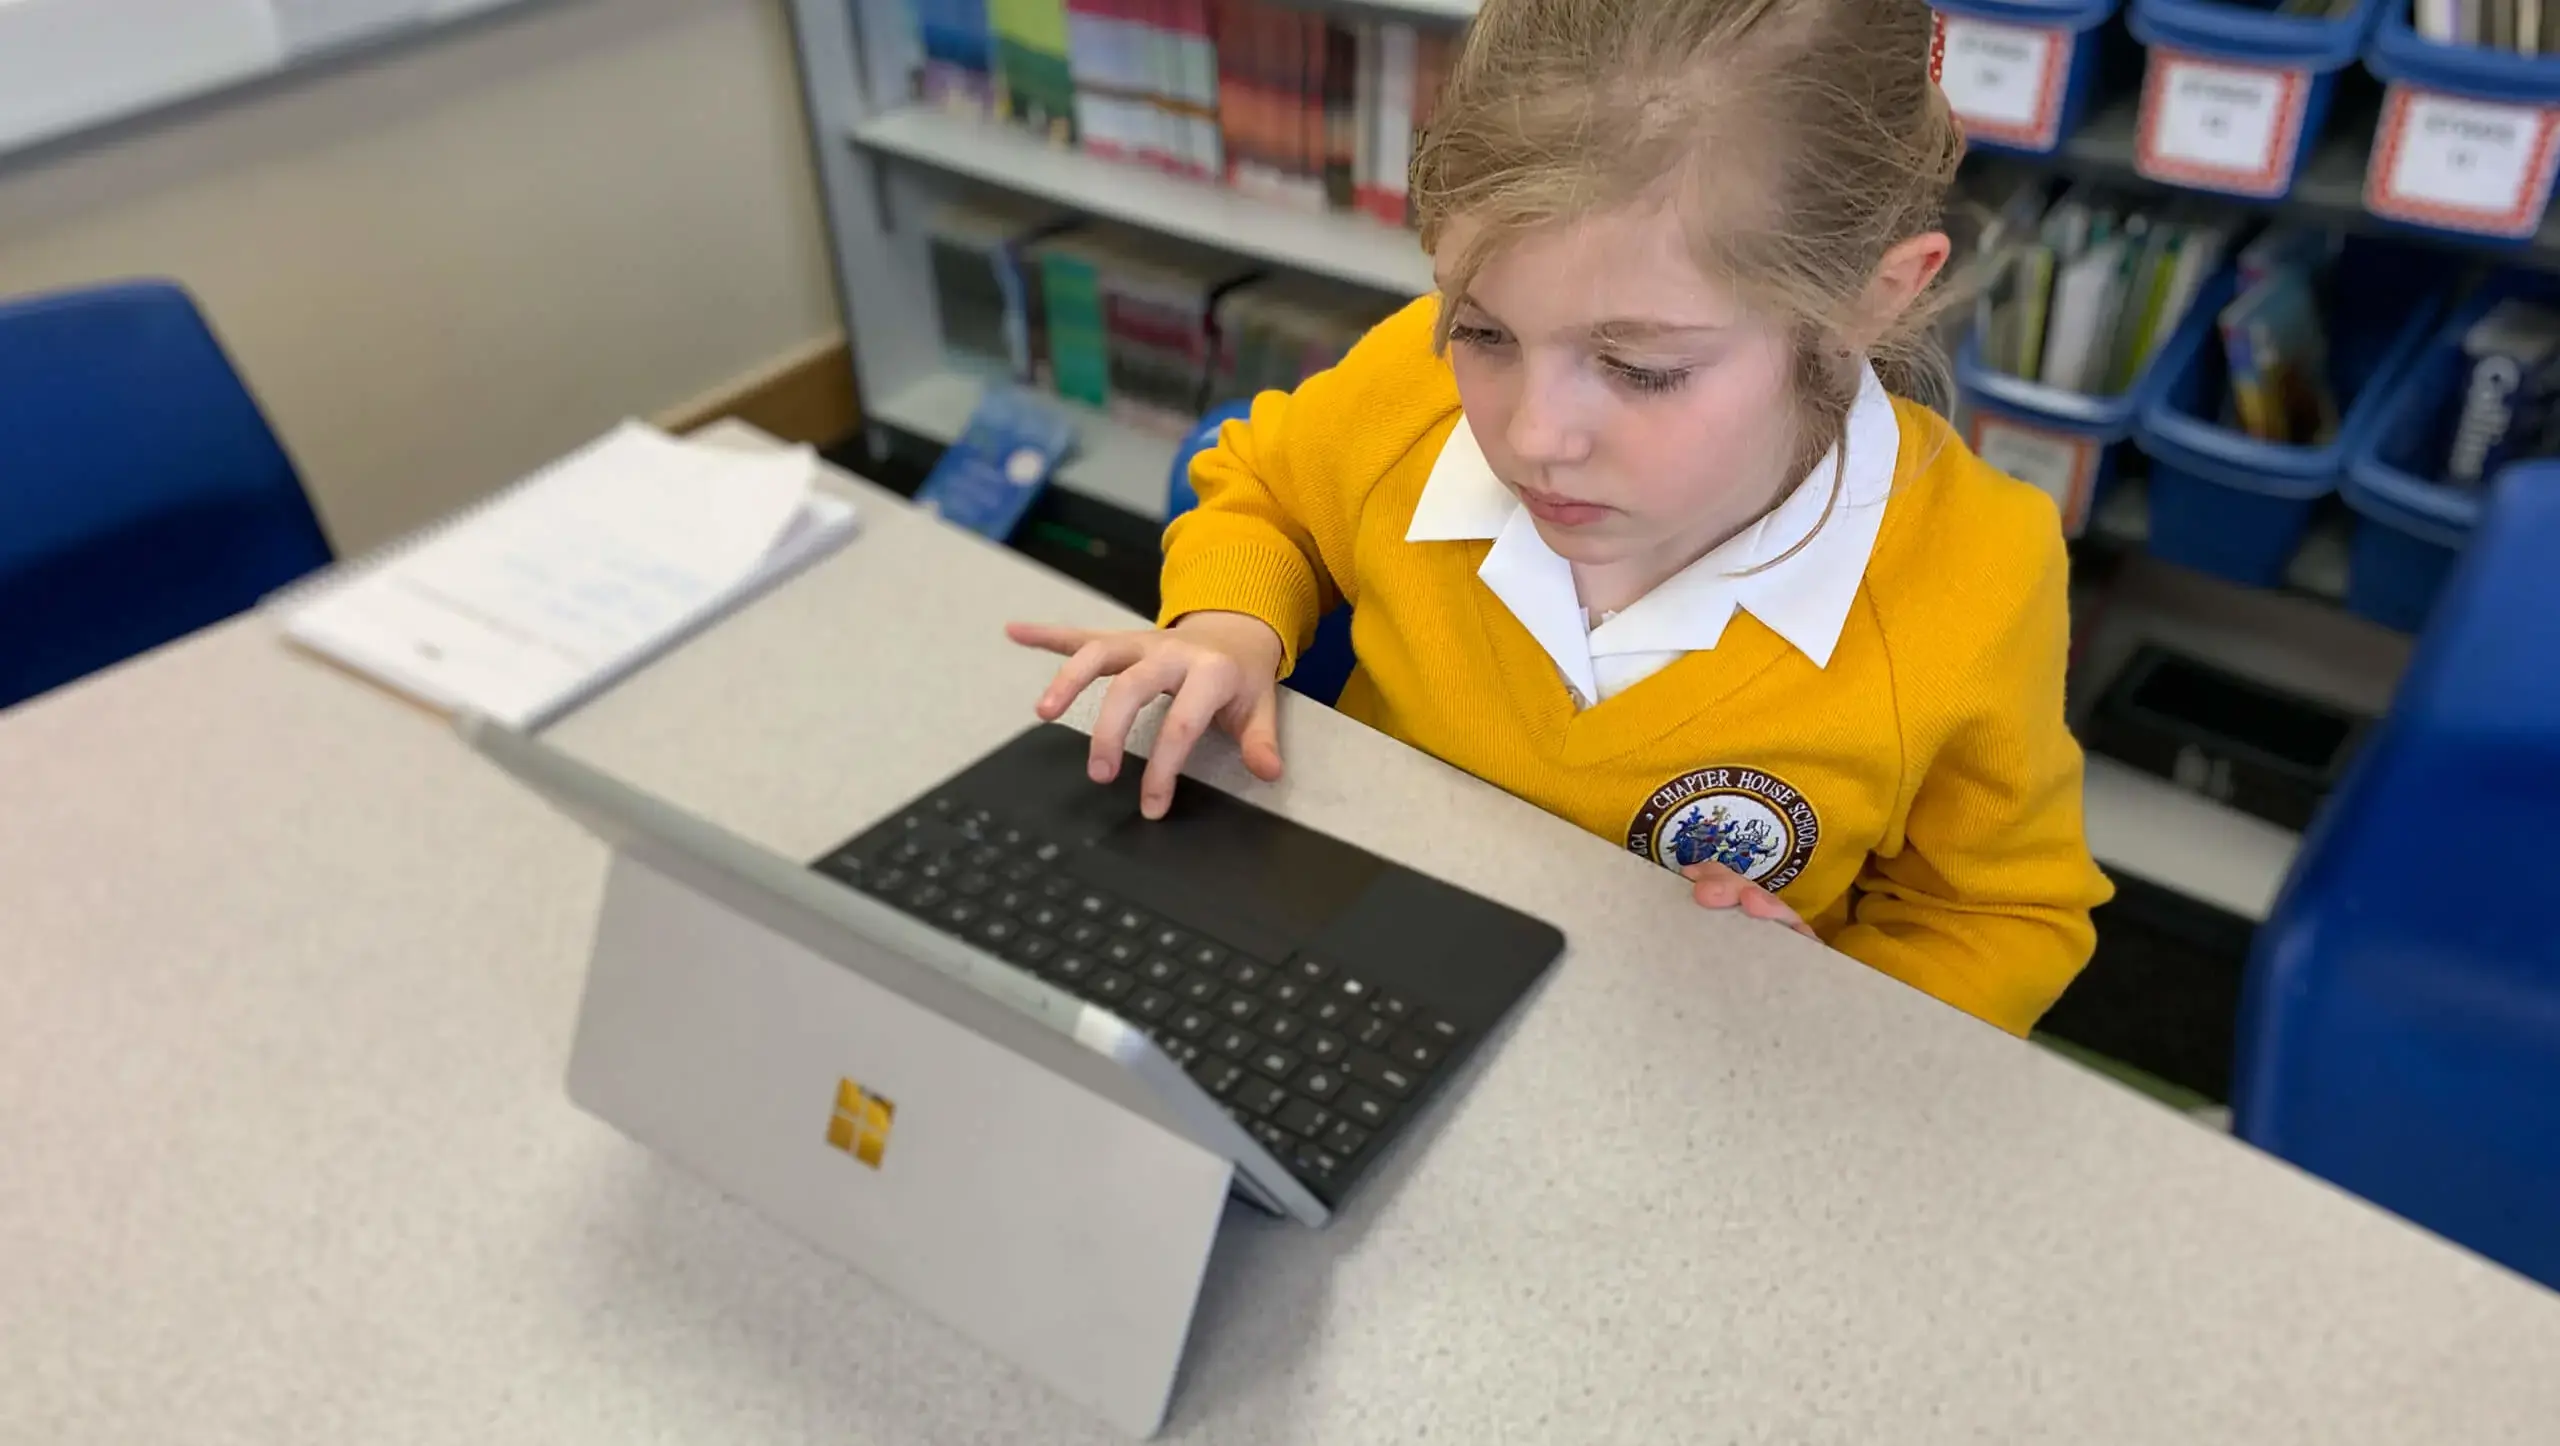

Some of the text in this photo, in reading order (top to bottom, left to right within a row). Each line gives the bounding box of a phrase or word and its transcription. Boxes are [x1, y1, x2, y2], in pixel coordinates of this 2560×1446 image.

[1653, 769, 1817, 853] CHAPTER HOUSE SCHOOL
